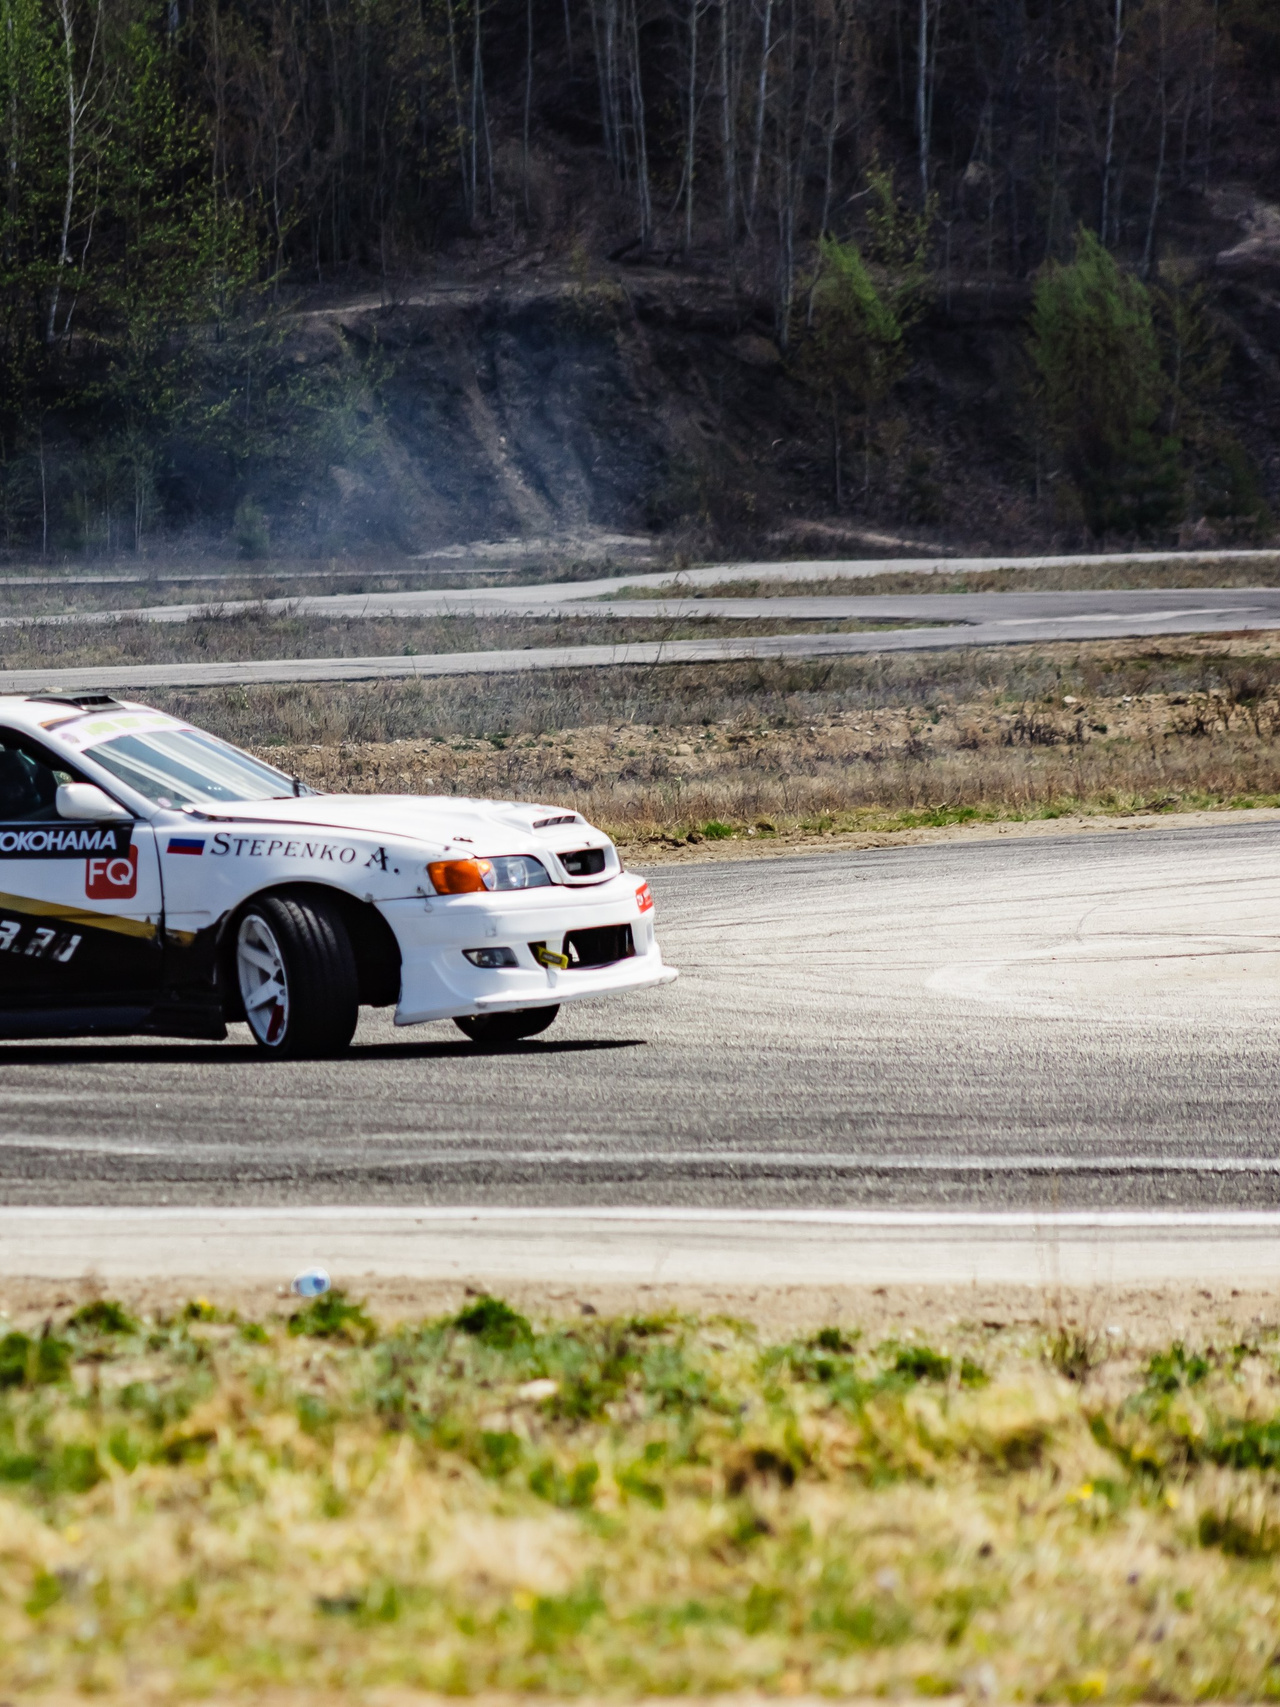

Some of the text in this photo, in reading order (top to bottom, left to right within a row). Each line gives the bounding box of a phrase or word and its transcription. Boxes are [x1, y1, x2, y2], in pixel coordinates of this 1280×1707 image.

[210, 832, 401, 875] STEPENKO A.
[89, 858, 134, 886] FQ
